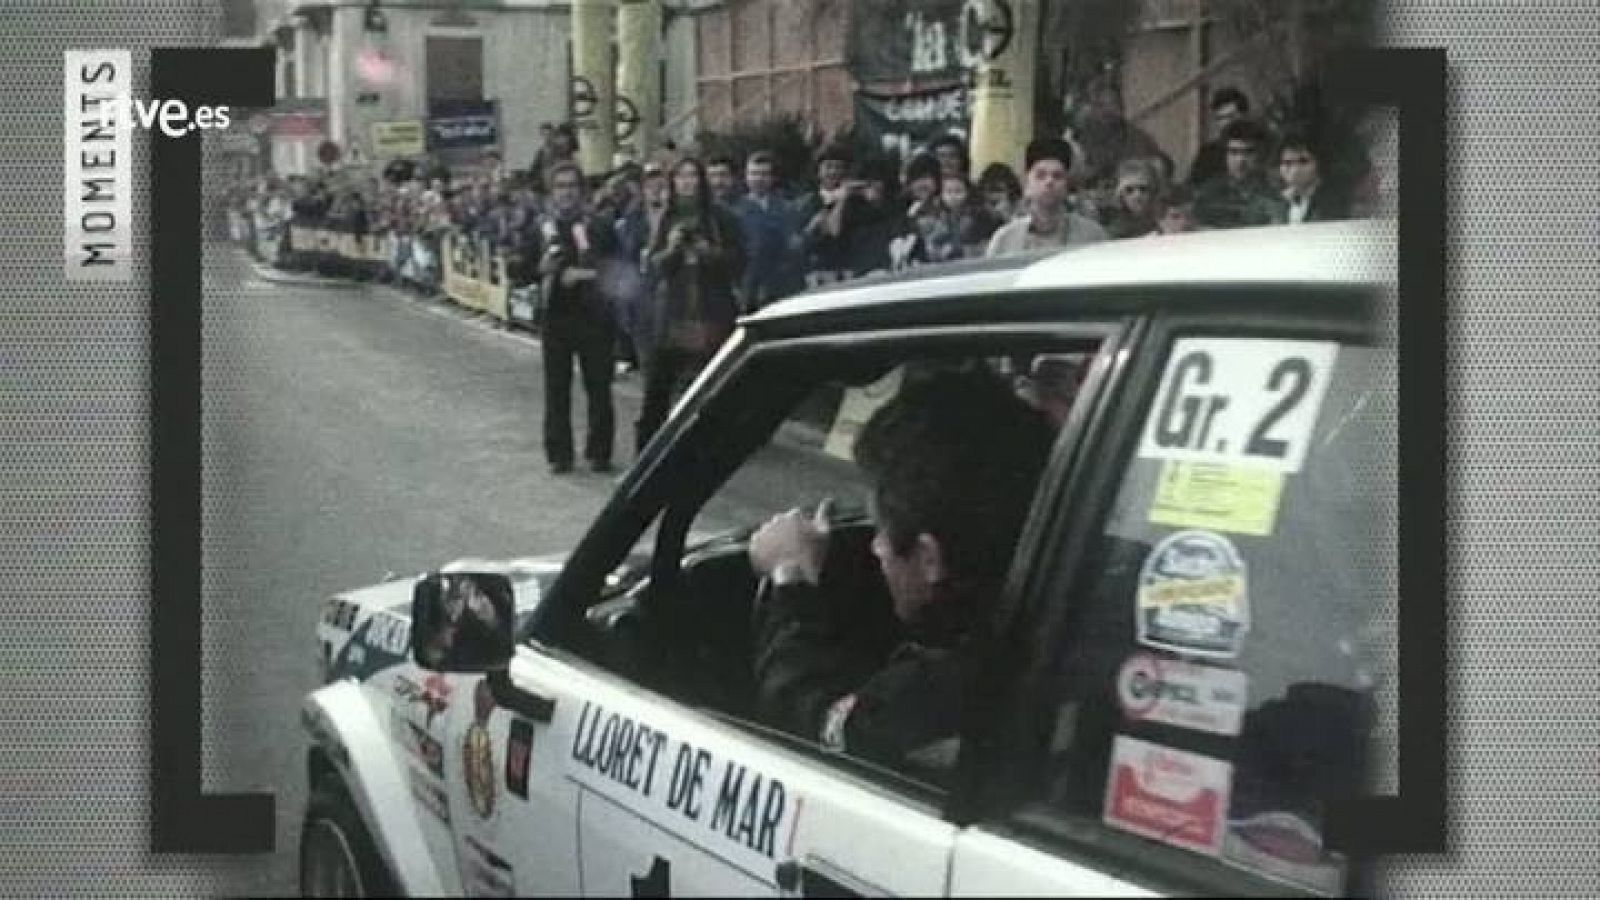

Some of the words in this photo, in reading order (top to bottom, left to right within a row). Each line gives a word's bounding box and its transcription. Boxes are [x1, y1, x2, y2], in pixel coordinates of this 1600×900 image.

[1155, 351, 1230, 453] Gr.
[1244, 356, 1313, 458] 2
[572, 700, 668, 797] LLORET
[666, 742, 712, 820] DE
[710, 760, 785, 859] MAR
